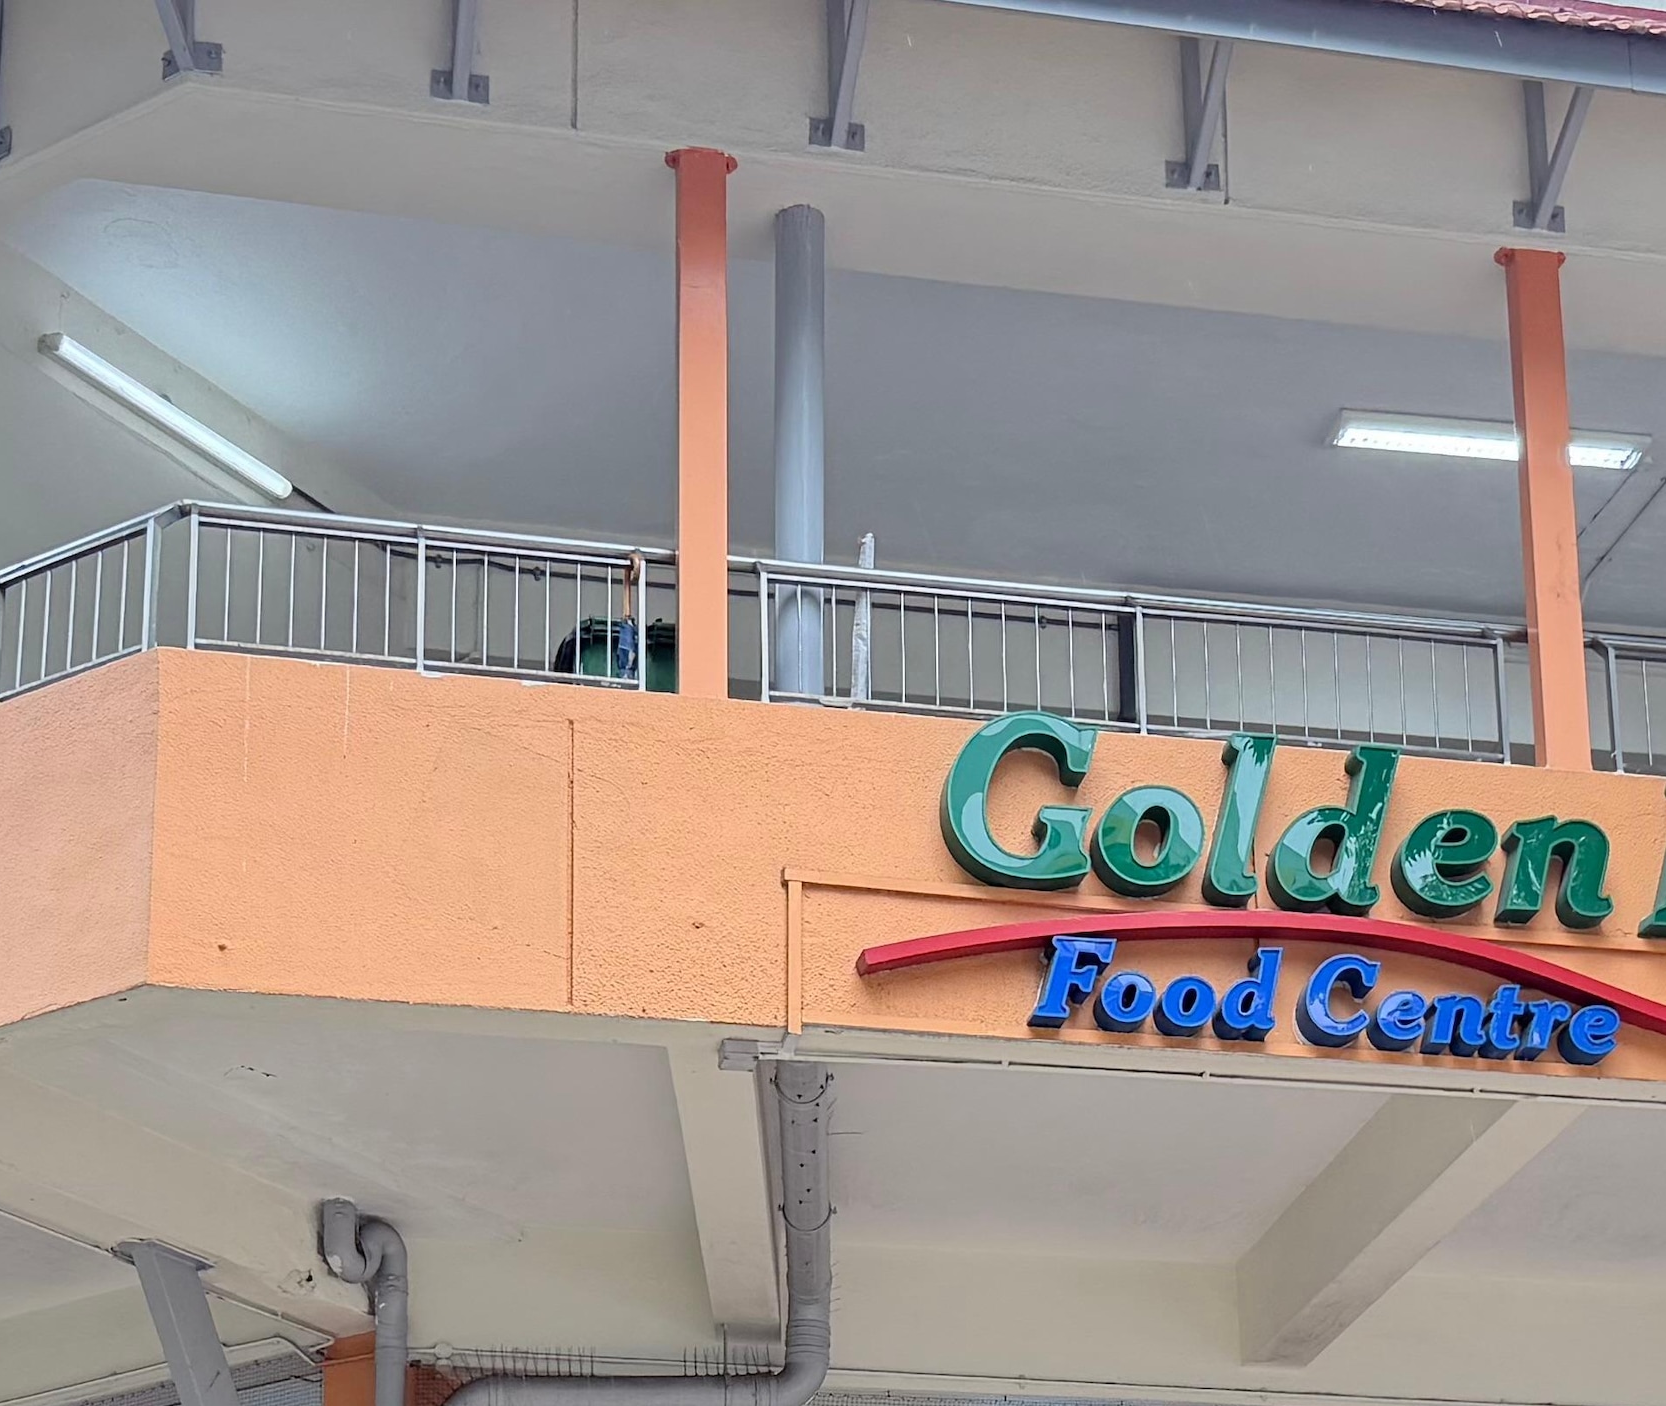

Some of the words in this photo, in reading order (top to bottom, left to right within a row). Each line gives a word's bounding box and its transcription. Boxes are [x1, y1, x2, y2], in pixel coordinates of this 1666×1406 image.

[940, 710, 1612, 929] Golden
[1027, 934, 1284, 1042] Food
[1294, 953, 1621, 1066] Centre
